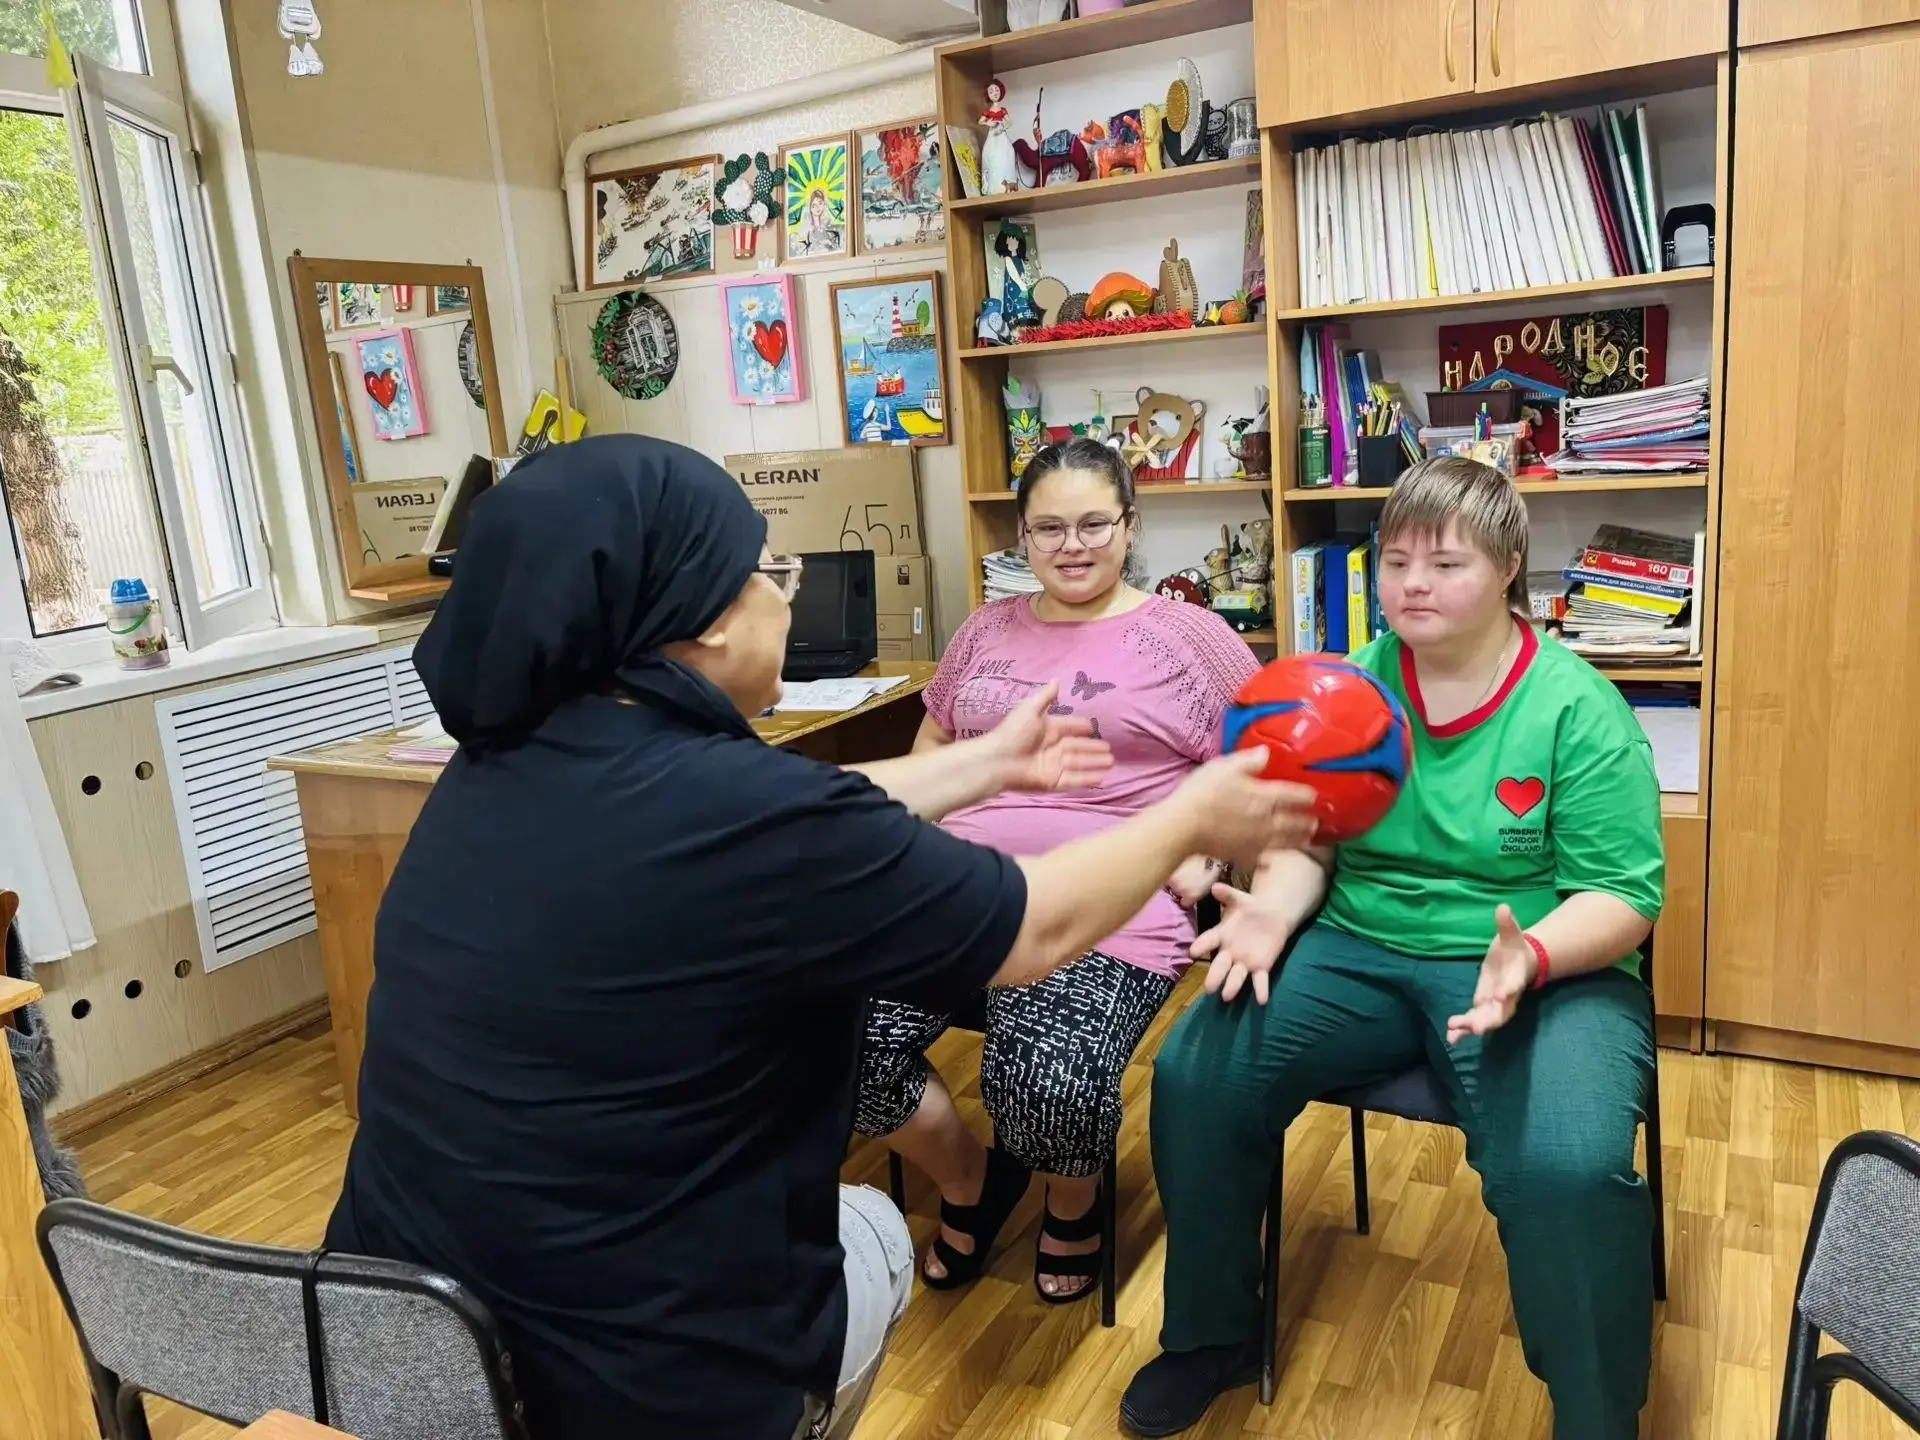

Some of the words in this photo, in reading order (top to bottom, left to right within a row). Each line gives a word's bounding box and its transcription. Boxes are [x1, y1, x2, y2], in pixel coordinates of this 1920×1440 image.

[740, 468, 820, 486] LERAN
[1648, 563, 1668, 575] 160
[1503, 836, 1539, 844] LONDON
[1500, 844, 1541, 852] ENGLAND
